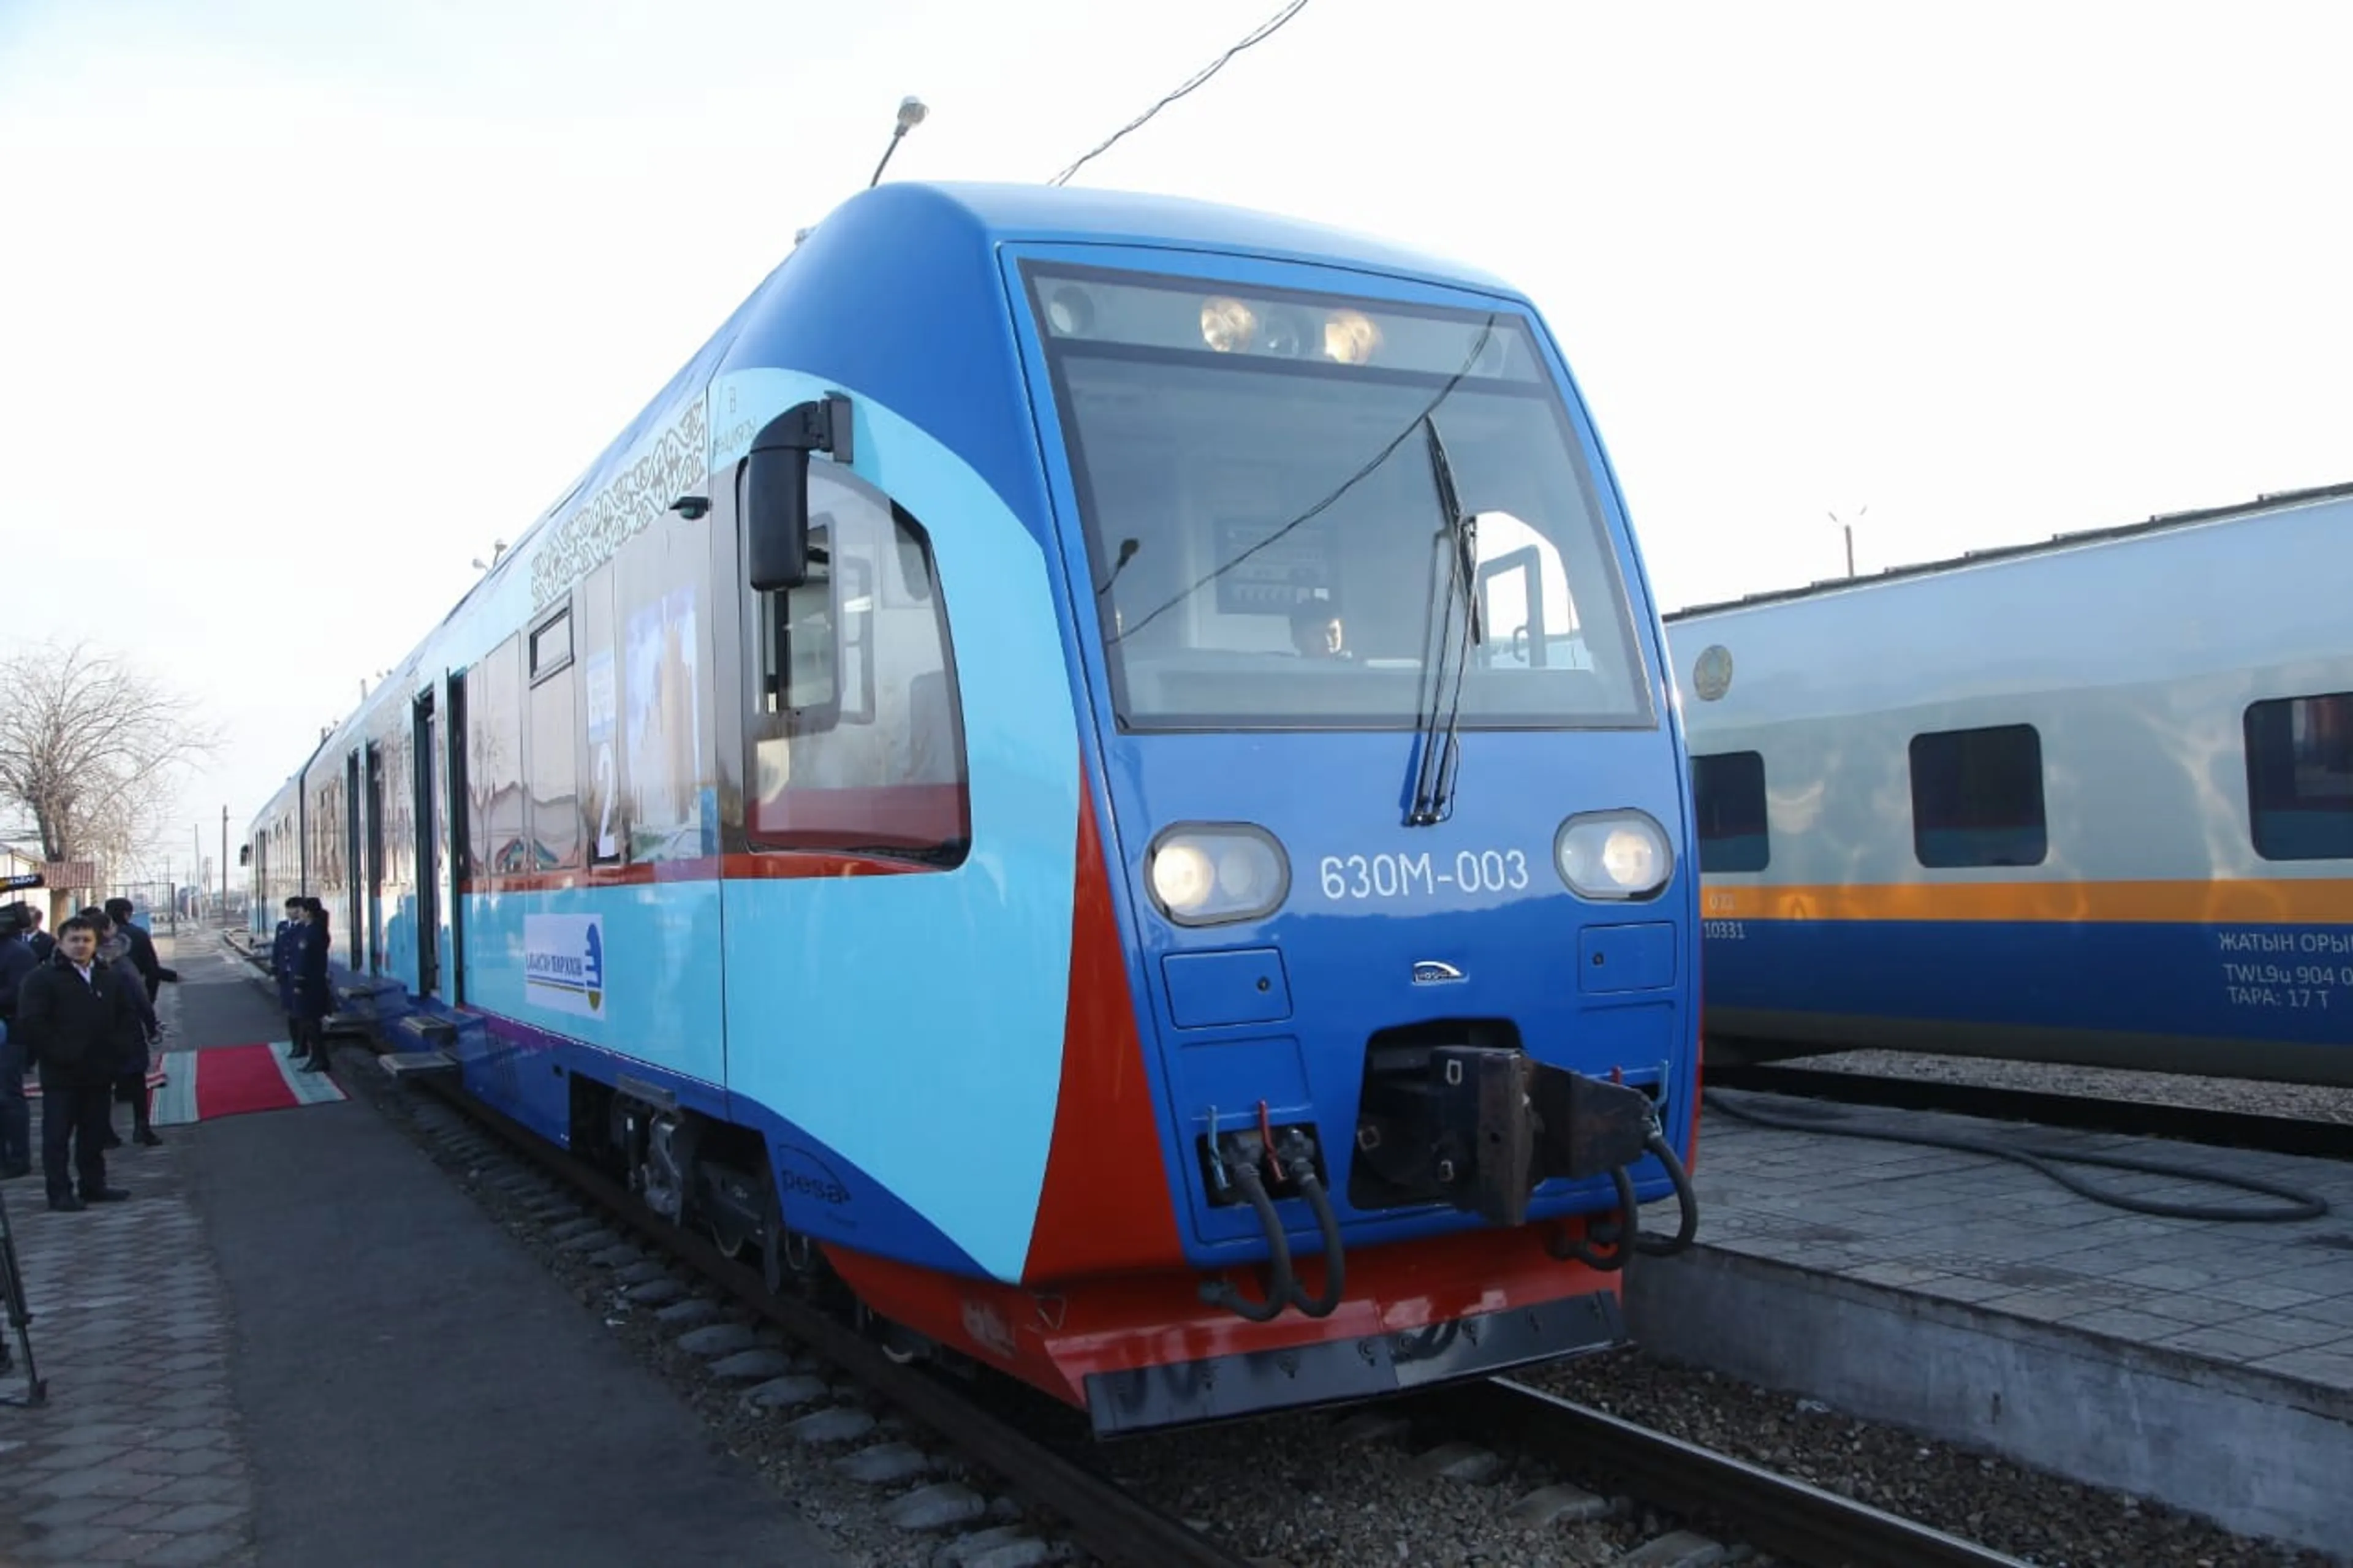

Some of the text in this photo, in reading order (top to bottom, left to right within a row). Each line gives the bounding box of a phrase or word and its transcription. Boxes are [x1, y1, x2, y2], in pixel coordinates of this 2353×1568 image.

[1320, 849, 1529, 900] 630M-003
[1703, 921, 1746, 939] 10331
[2218, 931, 2294, 951] ЖАТЫН
[2296, 966, 2335, 985] 904
[2287, 988, 2310, 1008] 17
[781, 1169, 843, 1205] pesa
